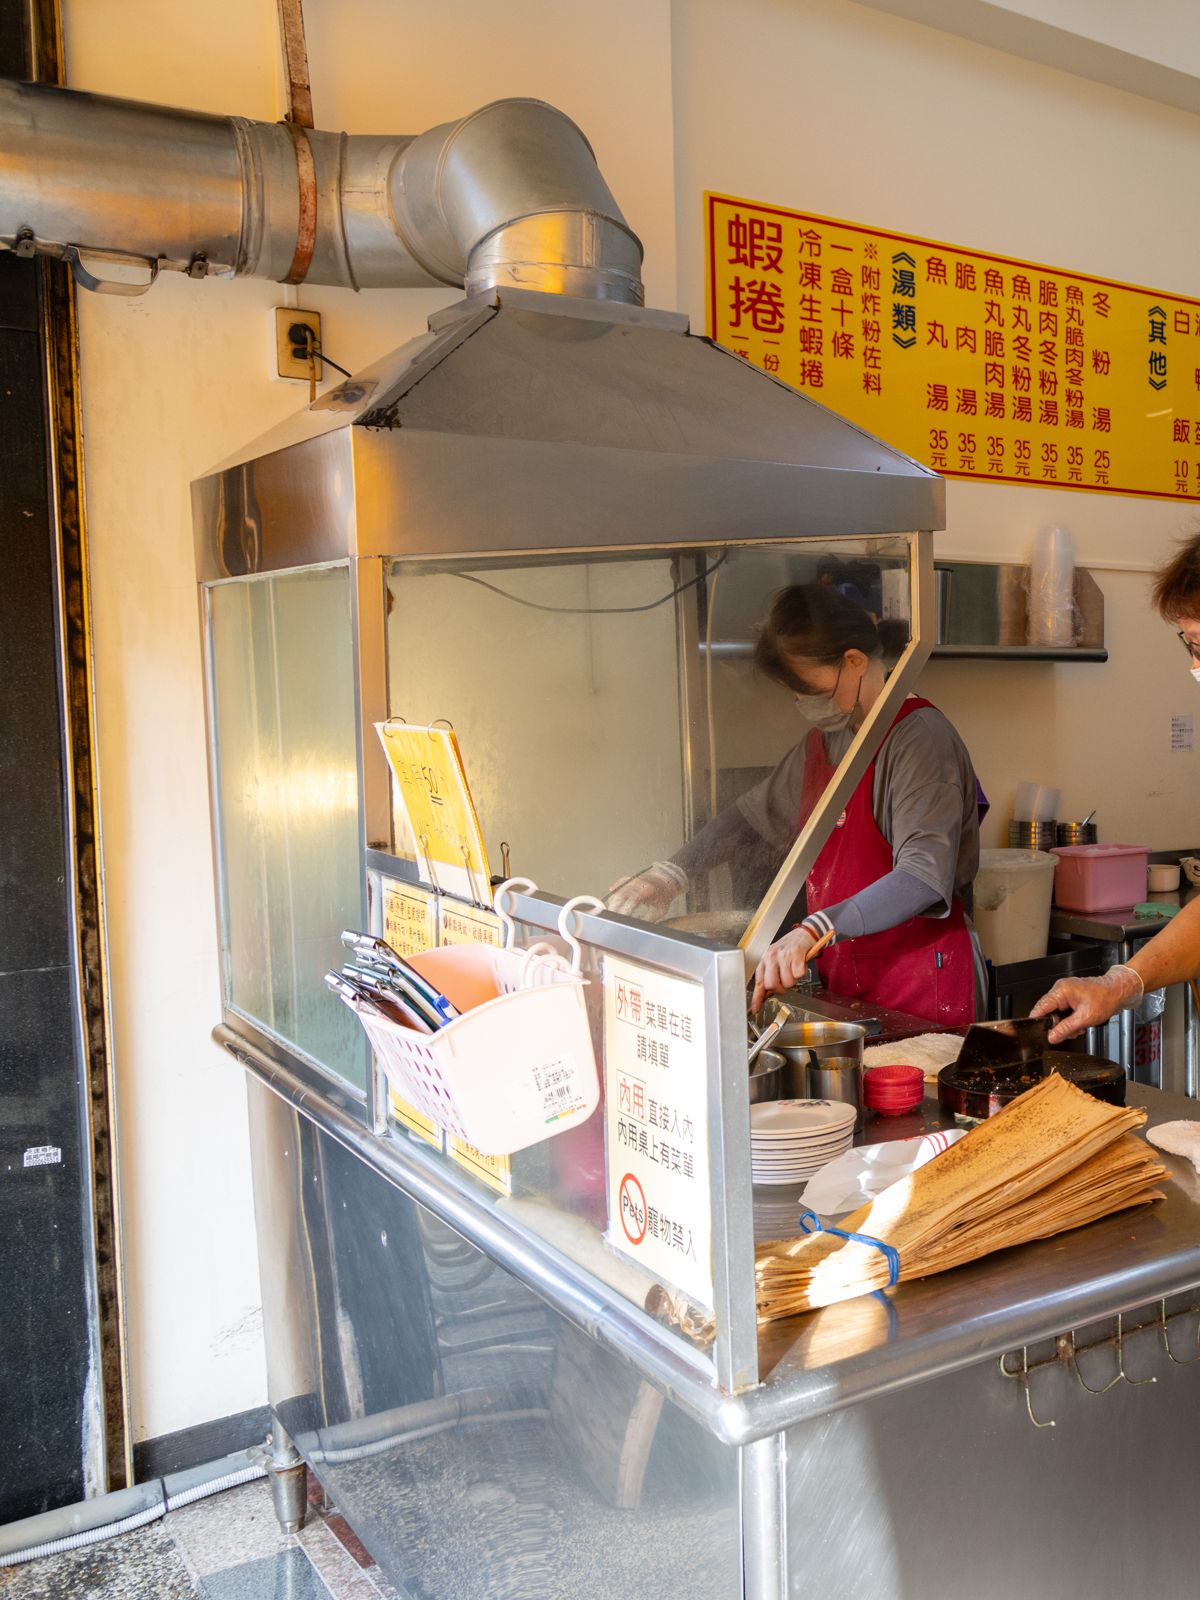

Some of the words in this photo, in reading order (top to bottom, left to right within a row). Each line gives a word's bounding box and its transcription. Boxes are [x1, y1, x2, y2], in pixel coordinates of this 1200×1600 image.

[727, 213, 785, 335] 蝦捲
[798, 228, 824, 389] 冷凍生蝦捲
[829, 243, 855, 361] 一盒十條
[925, 256, 949, 412] 魚丸湯
[955, 262, 978, 416] 脆肉湯
[983, 268, 1006, 419] 魚丸脆肉湯
[1011, 274, 1033, 423] 魚丸冬粉湯
[1038, 279, 1059, 427] 脆肉冬粉湯
[1064, 285, 1085, 430] 魚丸脆肉冬粉湯
[1091, 291, 1112, 434] 冬粉湯
[616, 983, 643, 1023] 外帶
[645, 1001, 693, 1043] 菜單在這
[637, 1033, 670, 1070] 請填單
[617, 1118, 694, 1180] 內用桌上有菜單
[618, 1078, 645, 1120] 內用
[647, 1098, 694, 1145] 直接入內
[622, 1194, 644, 1225] Pets
[647, 1206, 697, 1262] 寵物禁入
